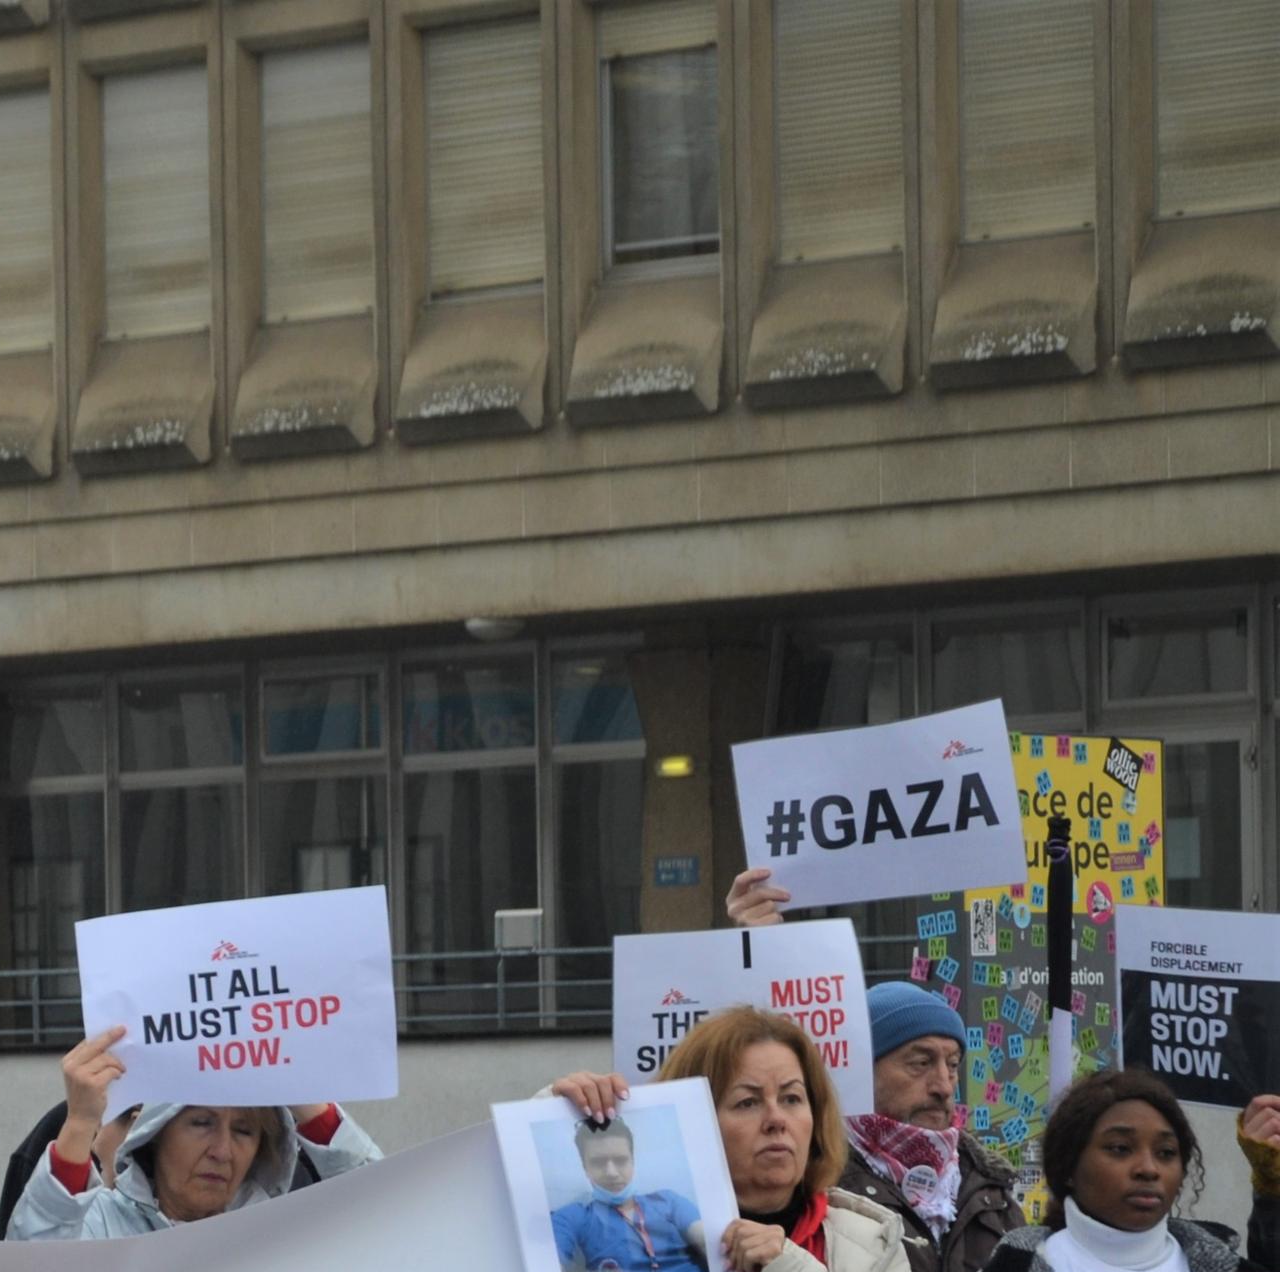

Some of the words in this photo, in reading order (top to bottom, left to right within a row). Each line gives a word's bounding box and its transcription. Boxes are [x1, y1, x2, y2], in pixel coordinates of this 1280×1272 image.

[1106, 757, 1139, 790] wood
[1110, 747, 1138, 775] ollie
[765, 772, 1000, 857] #GAZA
[1077, 782, 1114, 819] de
[1151, 941, 1208, 956] FORCIBLE
[1151, 956, 1244, 974] DISPLACEMENT
[188, 971, 218, 1003] IT
[228, 965, 289, 999] ALL
[770, 975, 844, 1008] MUST
[1150, 980, 1239, 1015] MUST
[143, 1005, 241, 1044] MUST
[251, 995, 341, 1033] STOP
[780, 1008, 845, 1037] TOP
[1150, 1013, 1228, 1046] STOP
[197, 1036, 291, 1072] NOW.
[1152, 1044, 1230, 1080] NOW.
